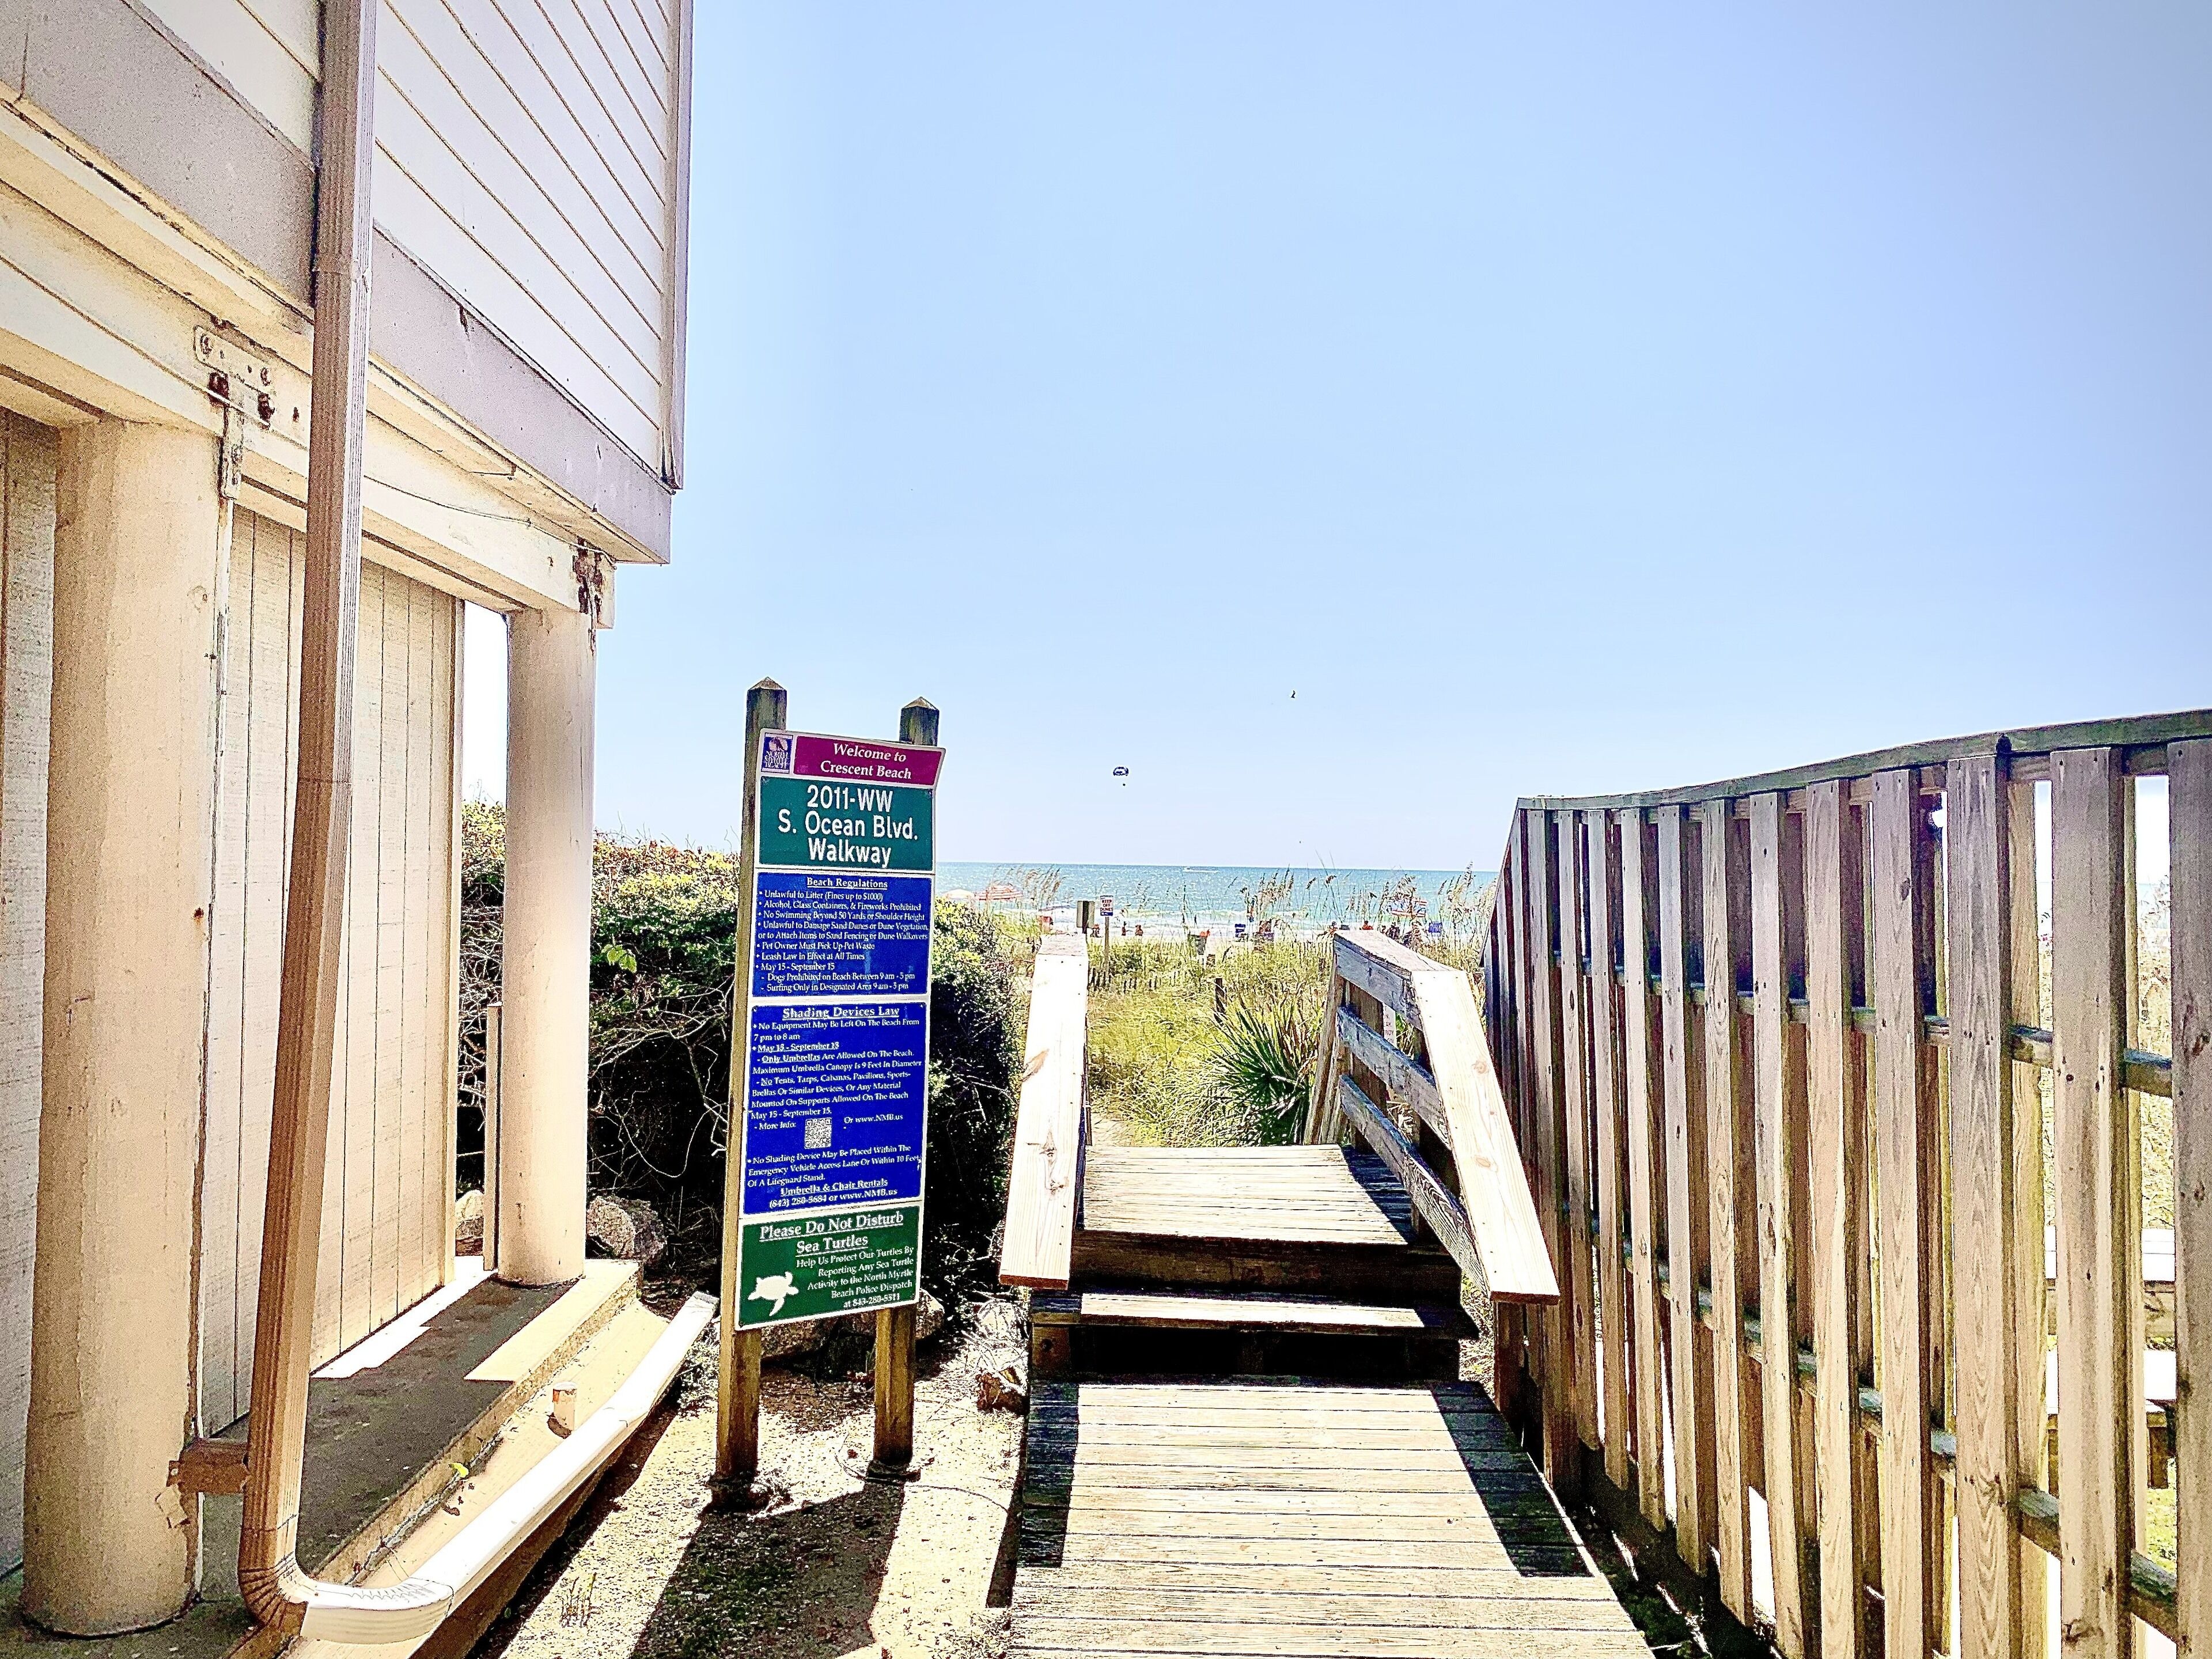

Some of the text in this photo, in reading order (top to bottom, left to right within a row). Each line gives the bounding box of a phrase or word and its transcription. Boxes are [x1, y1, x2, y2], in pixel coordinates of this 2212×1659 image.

[834, 743, 906, 762] Welcome to
[820, 760, 911, 779] Crescent Beach
[807, 785, 893, 813] 2011-WW
[778, 809, 918, 840] S. Ocean Blvd.
[808, 838, 892, 868] Walkway
[807, 877, 888, 888] Beach Regulations
[764, 890, 796, 898] Unlawful
[825, 892, 844, 901] (Fines
[863, 893, 883, 902] $1000)
[764, 900, 791, 909] Alcohol,
[775, 911, 811, 921] Swimming
[904, 913, 925, 922] Height
[804, 922, 830, 931] Damage
[762, 963, 775, 972] May
[791, 963, 825, 972] September
[768, 974, 785, 983] Dogs
[852, 972, 878, 980] Between
[783, 1006, 899, 1018] Shading Devices Law
[772, 1022, 810, 1031] Equipment
[813, 1021, 828, 1029] May
[791, 1042, 830, 1051] September
[783, 1054, 820, 1062] Umbrellas
[797, 1076, 819, 1084] Tarps,
[887, 1071, 911, 1080] Sports-
[751, 1112, 767, 1120] May
[783, 1109, 821, 1118] September
[855, 1113, 903, 1123] www.NMB.us
[767, 1176, 801, 1185] Lifeguard
[803, 1173, 825, 1181] Stand.
[781, 1185, 820, 1195] Umbrella
[832, 1181, 855, 1190] Chair
[857, 1178, 888, 1188] Rentals
[770, 1199, 790, 1209] (843)
[840, 1189, 897, 1200] www.NMB.us
[760, 1211, 904, 1240] Please Do Not Disturb
[796, 1234, 869, 1253] Sea Turtles
[796, 1246, 914, 1268] Help Us Protect Our Turtles By
[819, 1265, 857, 1278] Reporting
[858, 1263, 874, 1272] Any
[892, 1257, 914, 1266] Turtle
[808, 1280, 838, 1290] Activity
[850, 1276, 862, 1284] the
[864, 1272, 887, 1282] North
[889, 1270, 914, 1280] Myrtle
[832, 1279, 912, 1298] Beach Police Dispatch
[843, 1300, 851, 1308] at
